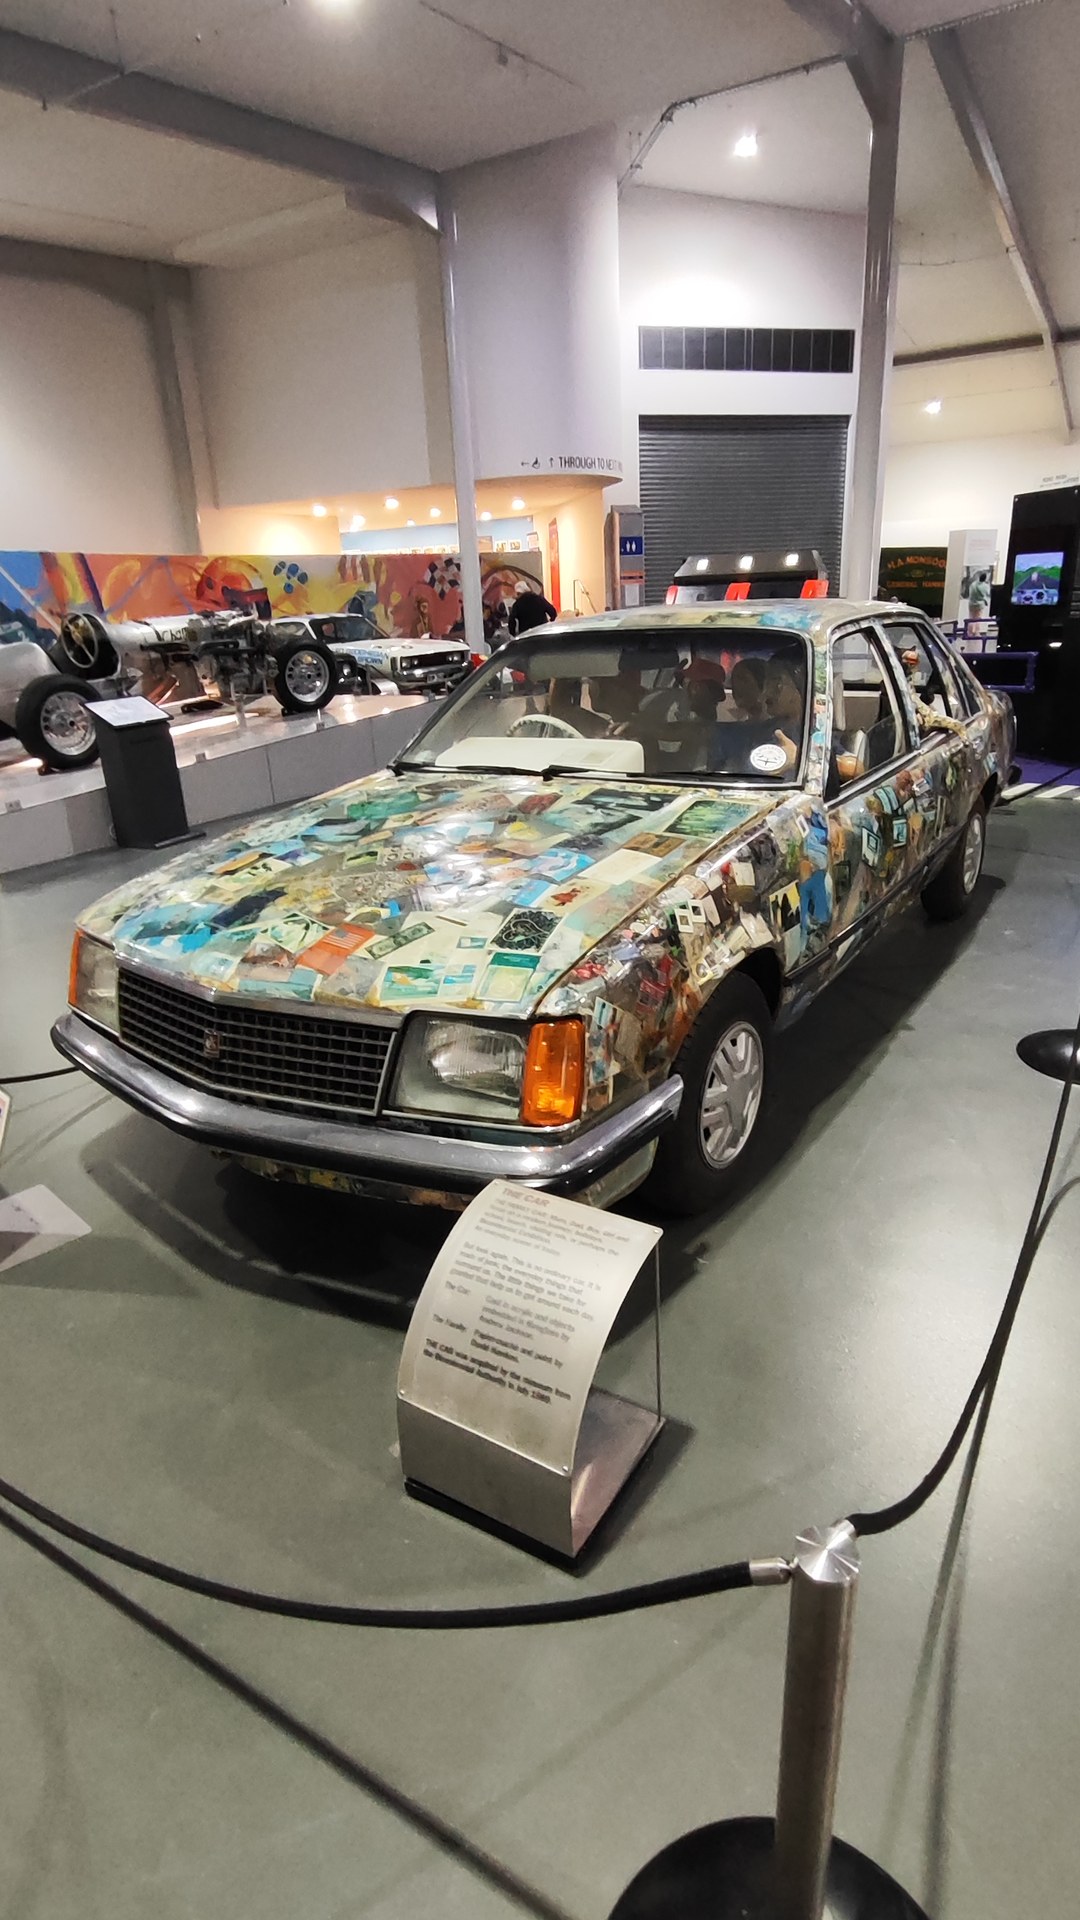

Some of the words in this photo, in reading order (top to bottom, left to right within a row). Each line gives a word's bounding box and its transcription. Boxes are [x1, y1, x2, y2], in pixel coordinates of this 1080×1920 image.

[559, 457, 596, 469] THROUGH
[597, 457, 605, 470] TO
[907, 555, 946, 568] MONSOO
[503, 1188, 525, 1199] THE
[524, 1196, 550, 1207] CAR
[513, 1257, 525, 1266] This
[544, 1270, 571, 1282] ordinary
[514, 1270, 544, 1283] everyday
[546, 1279, 566, 1290] things
[569, 1286, 583, 1295] that
[475, 1275, 490, 1285] that
[537, 1298, 561, 1309] around
[563, 1307, 580, 1315] each
[524, 1282, 545, 1294] things
[577, 1299, 587, 1307] for
[535, 1314, 549, 1322] and
[554, 1359, 563, 1369] by
